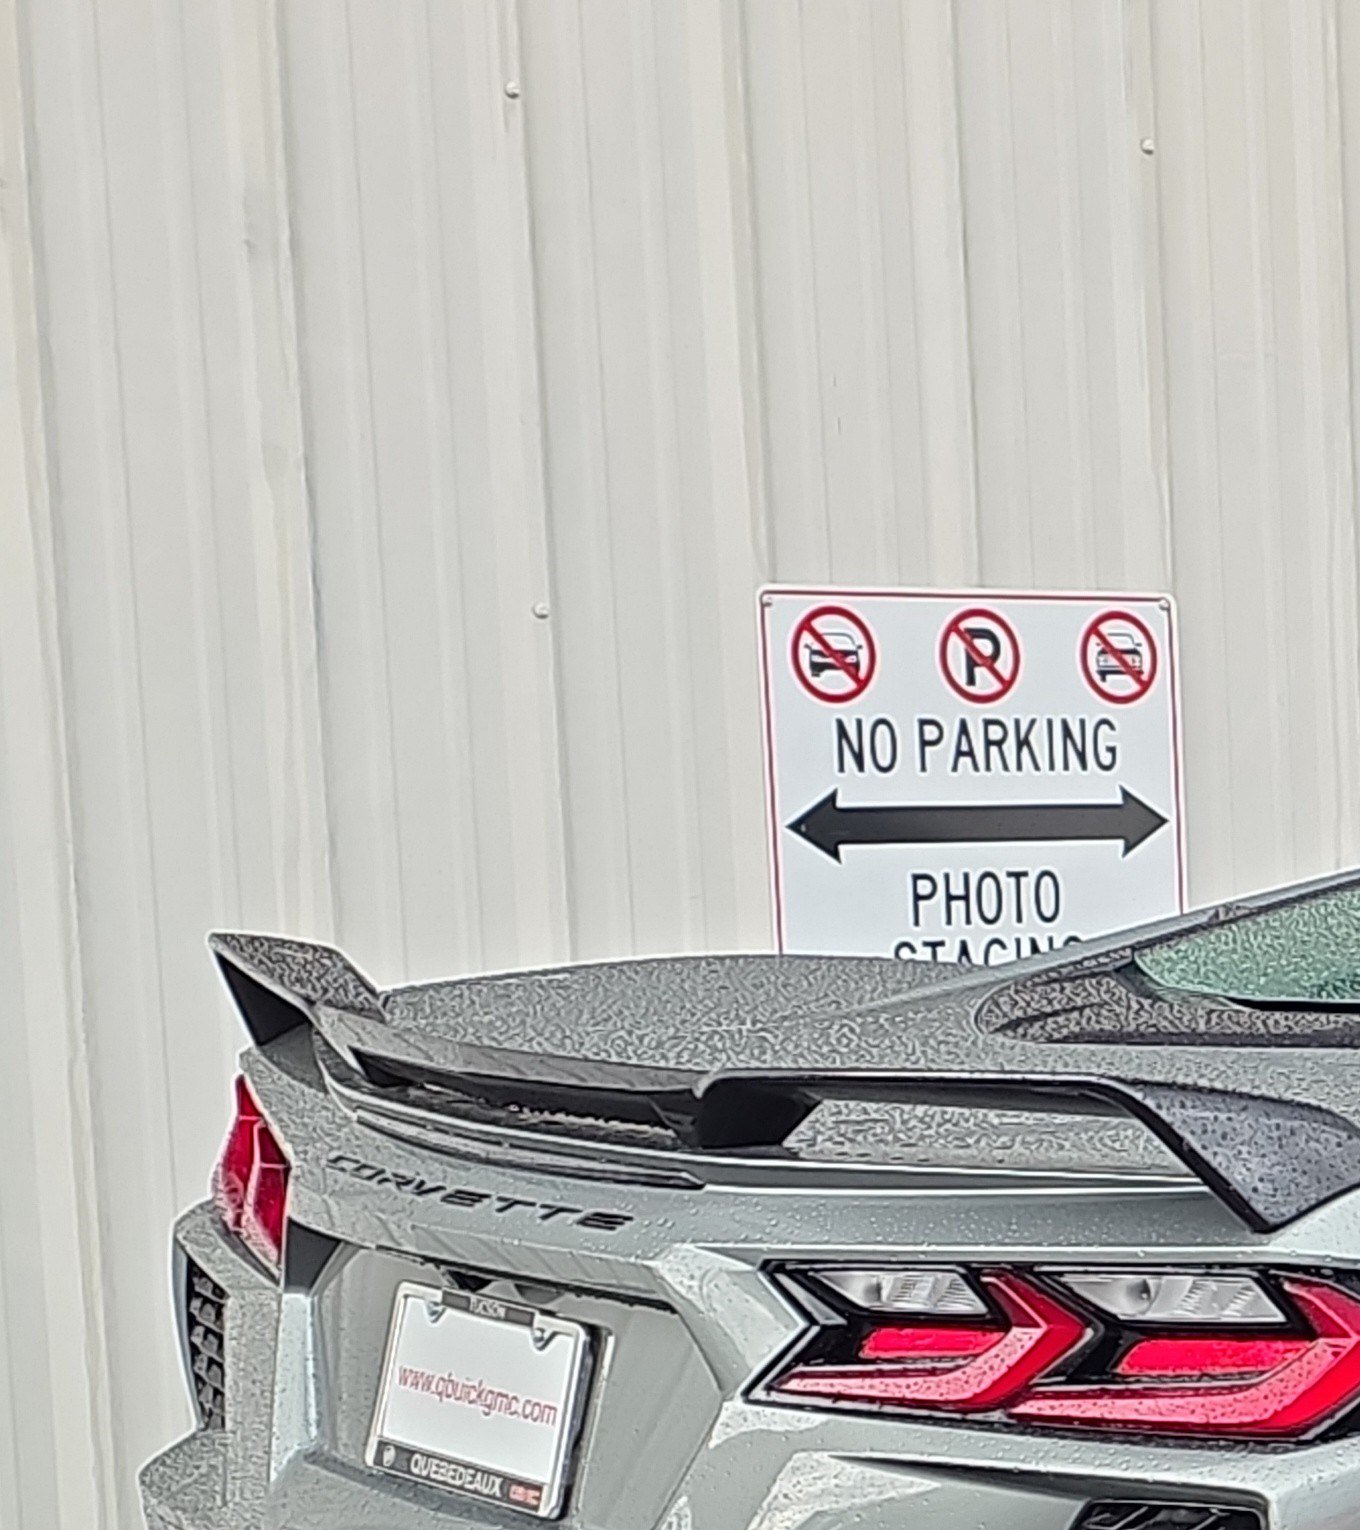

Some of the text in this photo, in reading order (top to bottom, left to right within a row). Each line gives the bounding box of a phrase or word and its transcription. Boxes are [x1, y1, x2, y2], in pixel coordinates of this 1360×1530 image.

[835, 717, 1118, 773] NO PARKING
[911, 870, 1060, 927] PHOTO
[326, 1154, 635, 1232] CORVETTE
[398, 1367, 558, 1428] www.qbuickgmc.com
[409, 1453, 504, 1497] QUEBEDEAUX
